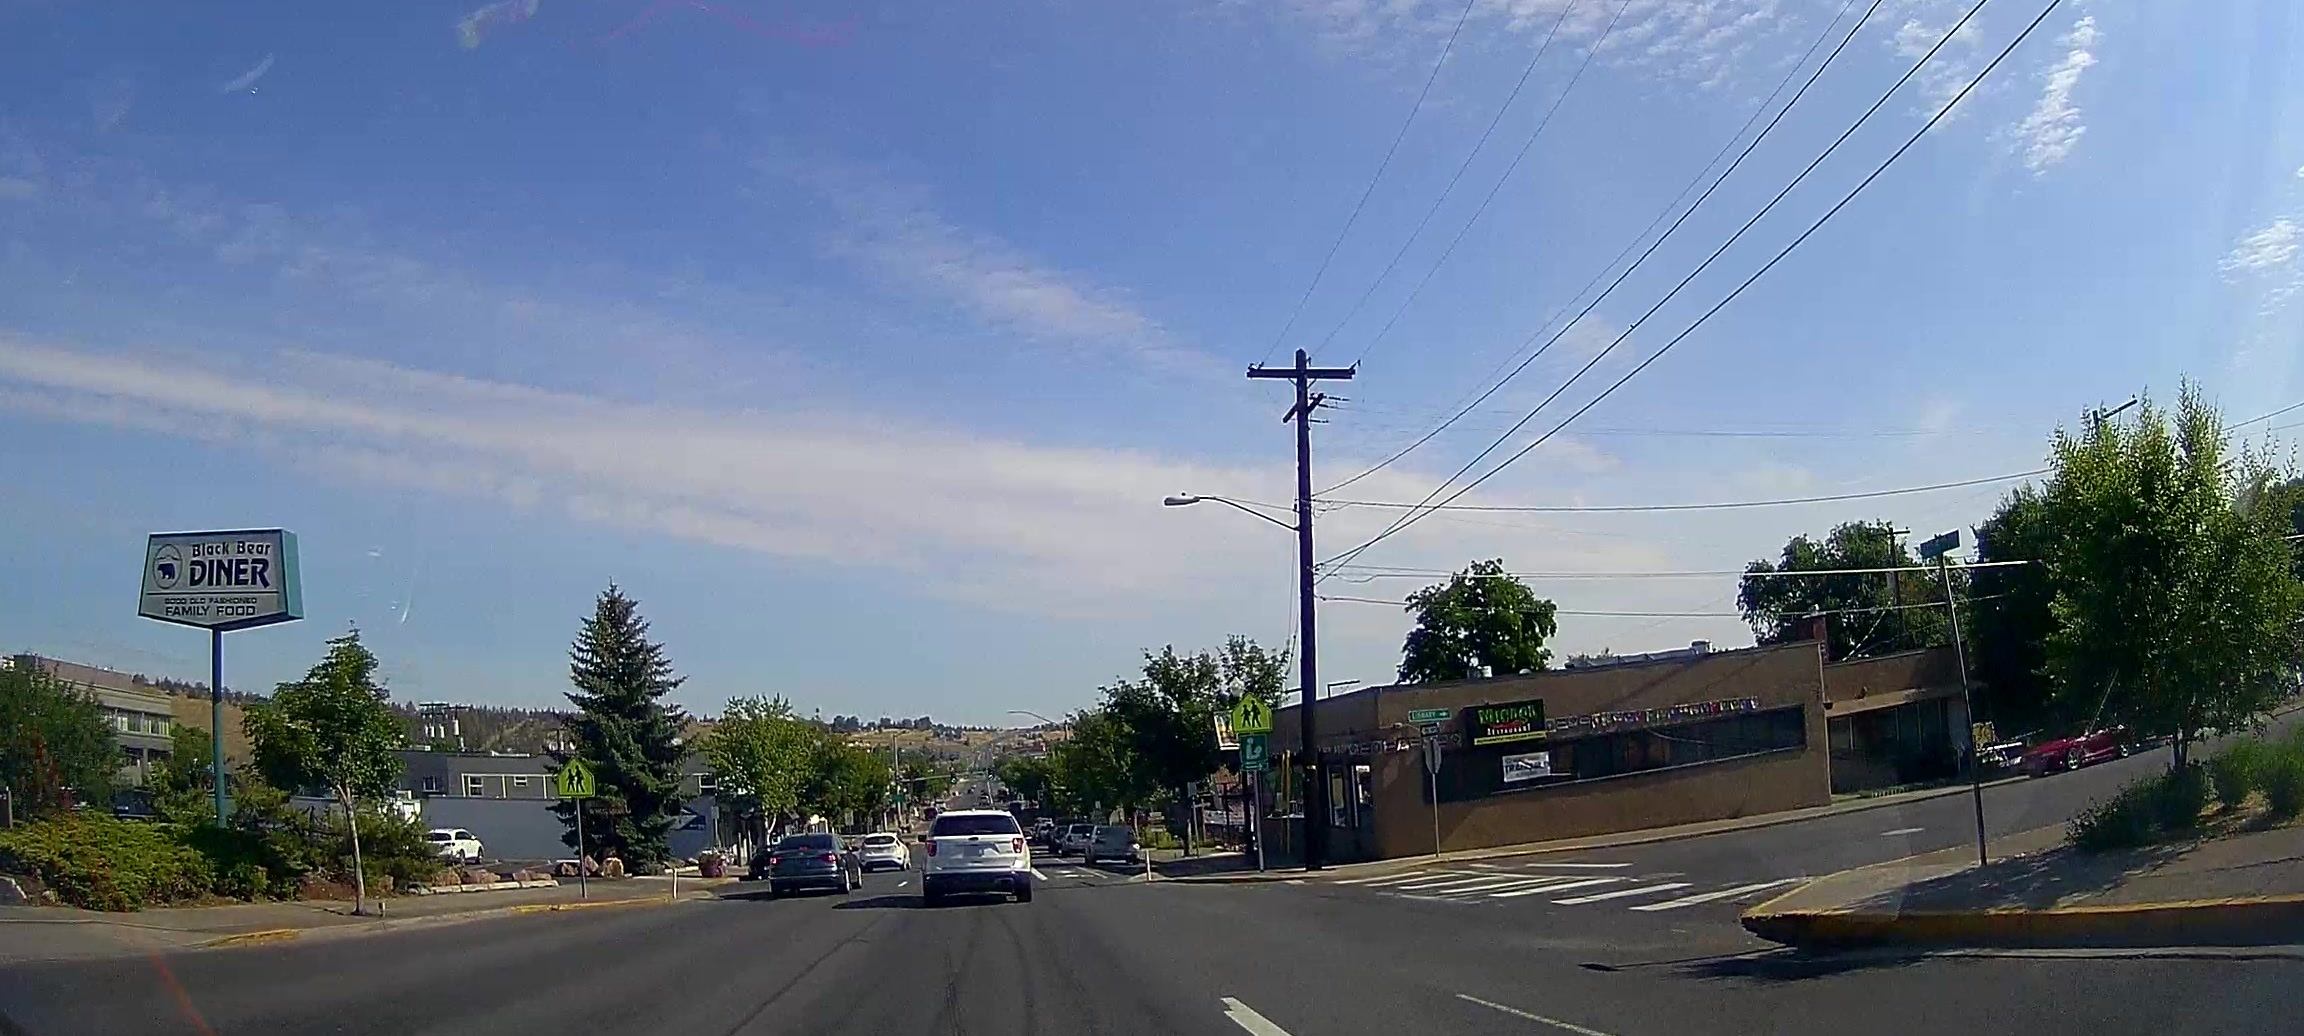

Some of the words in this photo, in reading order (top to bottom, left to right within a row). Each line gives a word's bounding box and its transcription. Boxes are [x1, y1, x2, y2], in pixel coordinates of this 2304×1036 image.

[192, 543, 229, 558] Black
[237, 540, 271, 556] Bear
[189, 558, 270, 588] DINER
[165, 605, 210, 616] FAMILY
[216, 605, 256, 616] FOOD
